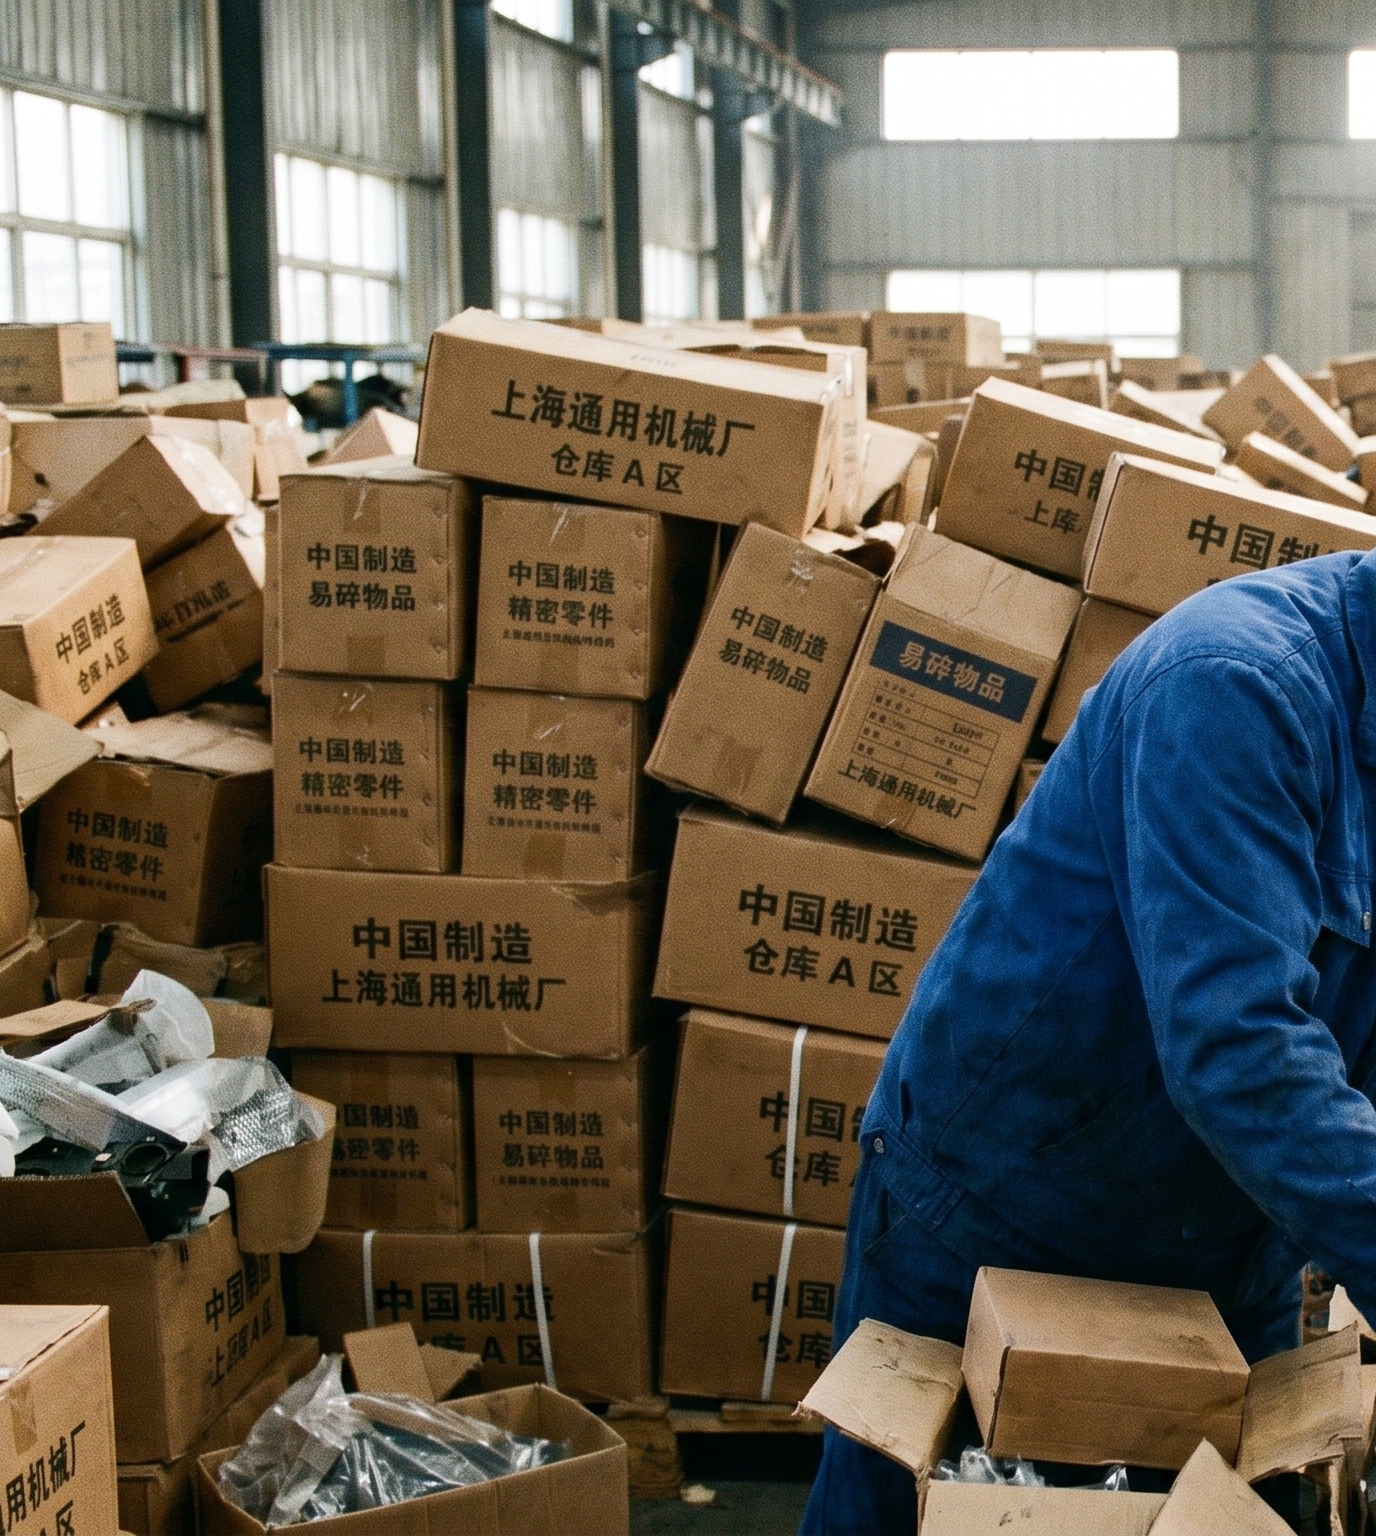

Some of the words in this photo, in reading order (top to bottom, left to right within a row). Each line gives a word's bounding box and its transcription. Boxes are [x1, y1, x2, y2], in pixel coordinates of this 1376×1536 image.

[492, 379, 755, 457] 上海通用机械厂
[307, 542, 417, 575] 中国制造
[1187, 514, 1336, 570] 中国制
[309, 581, 416, 612] 易碎物品
[508, 560, 616, 595] 中国制造
[55, 593, 126, 664] 中国制造
[508, 597, 614, 629] 精密零件
[730, 606, 830, 663] 中国制造
[719, 638, 811, 694] 易碎物品
[899, 641, 1005, 703] 易碎物品
[299, 737, 405, 766] 中国制造
[493, 749, 598, 780] 中国制造
[300, 772, 404, 800] 精密零件
[493, 784, 597, 815] 精密零件
[838, 759, 977, 819] 上海通用机械厂
[67, 807, 168, 848] 中国制造
[738, 884, 919, 952] 中国制造
[352, 917, 533, 964] 中国制造
[322, 969, 566, 1012] 上海通用机械厂
[336, 1104, 420, 1129] 国制造
[499, 1110, 604, 1137] 中国制造
[501, 1143, 604, 1169] 易碎物品
[764, 1144, 859, 1188] 仓库
[375, 1280, 556, 1323] 中国制造
[0, 1420, 86, 1536] 用机械厂
